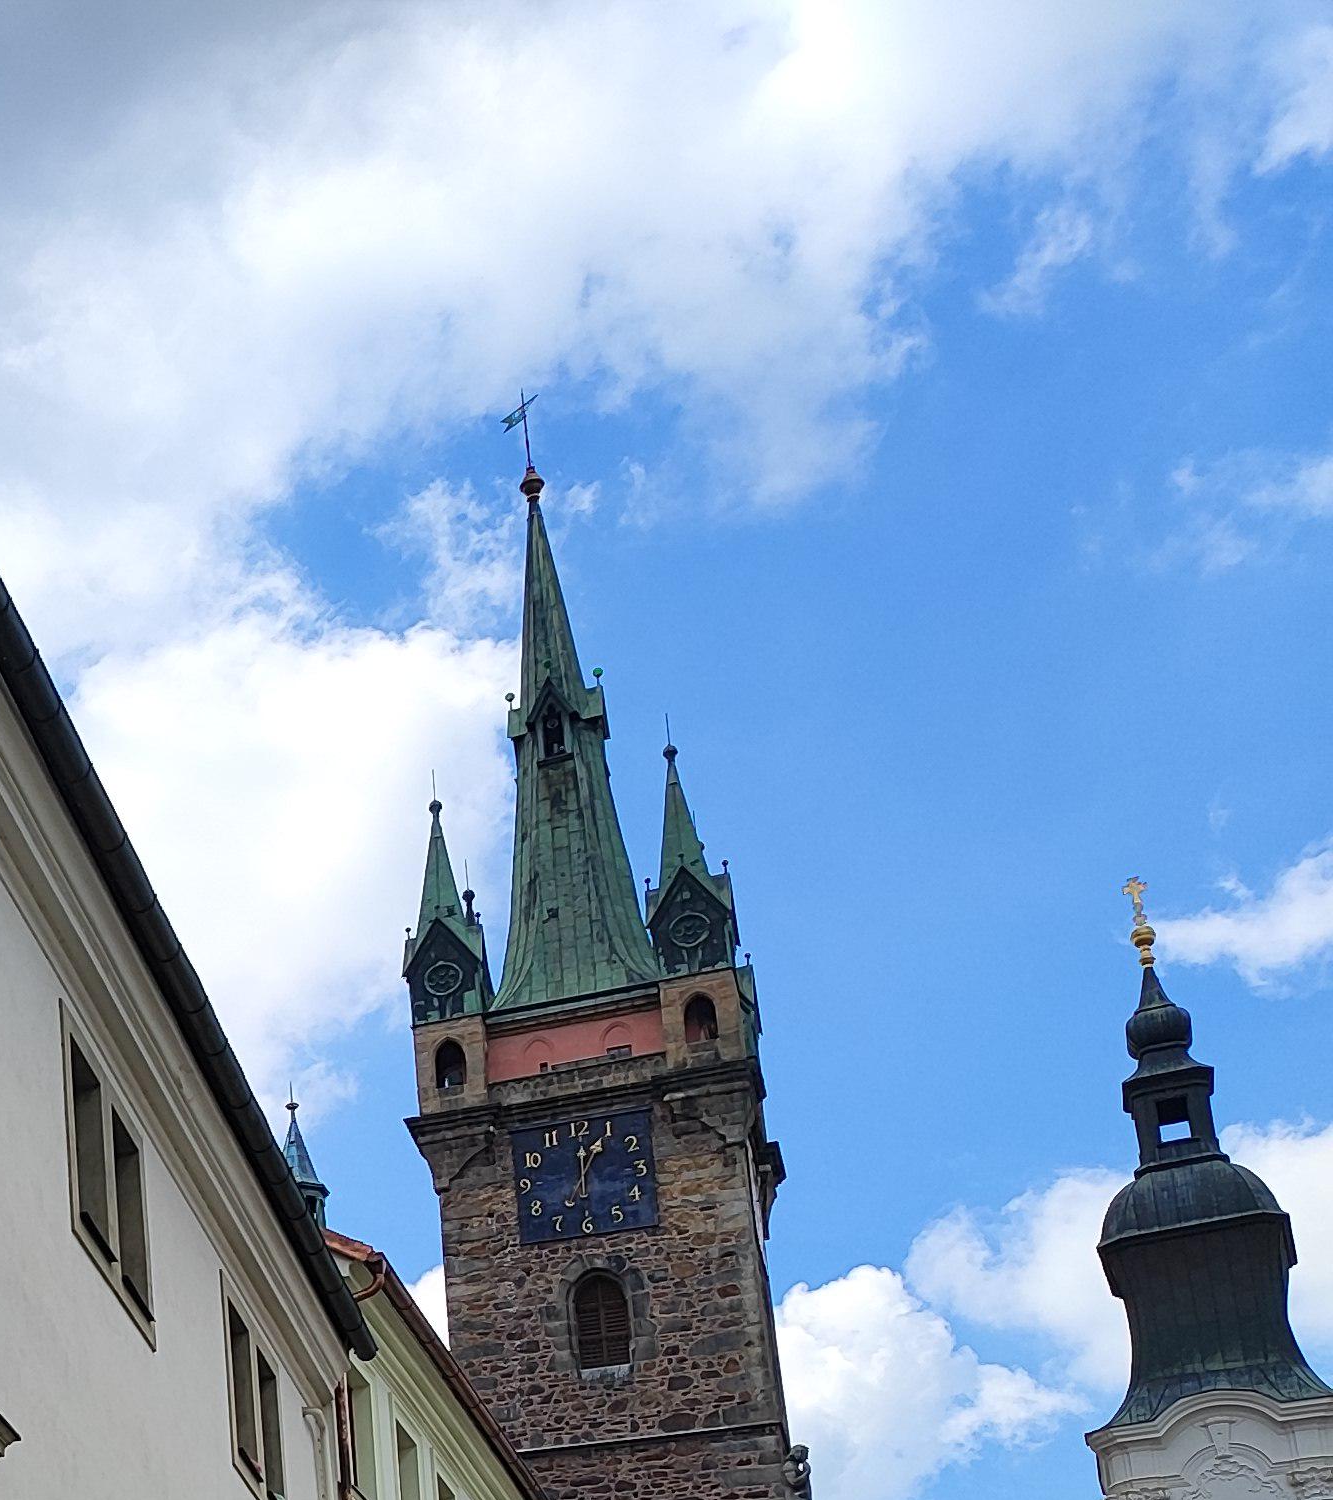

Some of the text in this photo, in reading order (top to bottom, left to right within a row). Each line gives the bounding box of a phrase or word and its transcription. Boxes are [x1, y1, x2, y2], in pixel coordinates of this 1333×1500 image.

[569, 1121, 589, 1138] 12
[605, 1121, 612, 1137] 1
[543, 1129, 559, 1149] 11
[624, 1135, 640, 1153] 2
[524, 1152, 542, 1169] 10
[633, 1159, 647, 1177] 3
[520, 1179, 531, 1194] 9
[628, 1184, 642, 1202] 4
[531, 1199, 543, 1217] 8
[611, 1205, 624, 1223] 5
[552, 1215, 564, 1232] 7
[582, 1216, 594, 1234] 6
